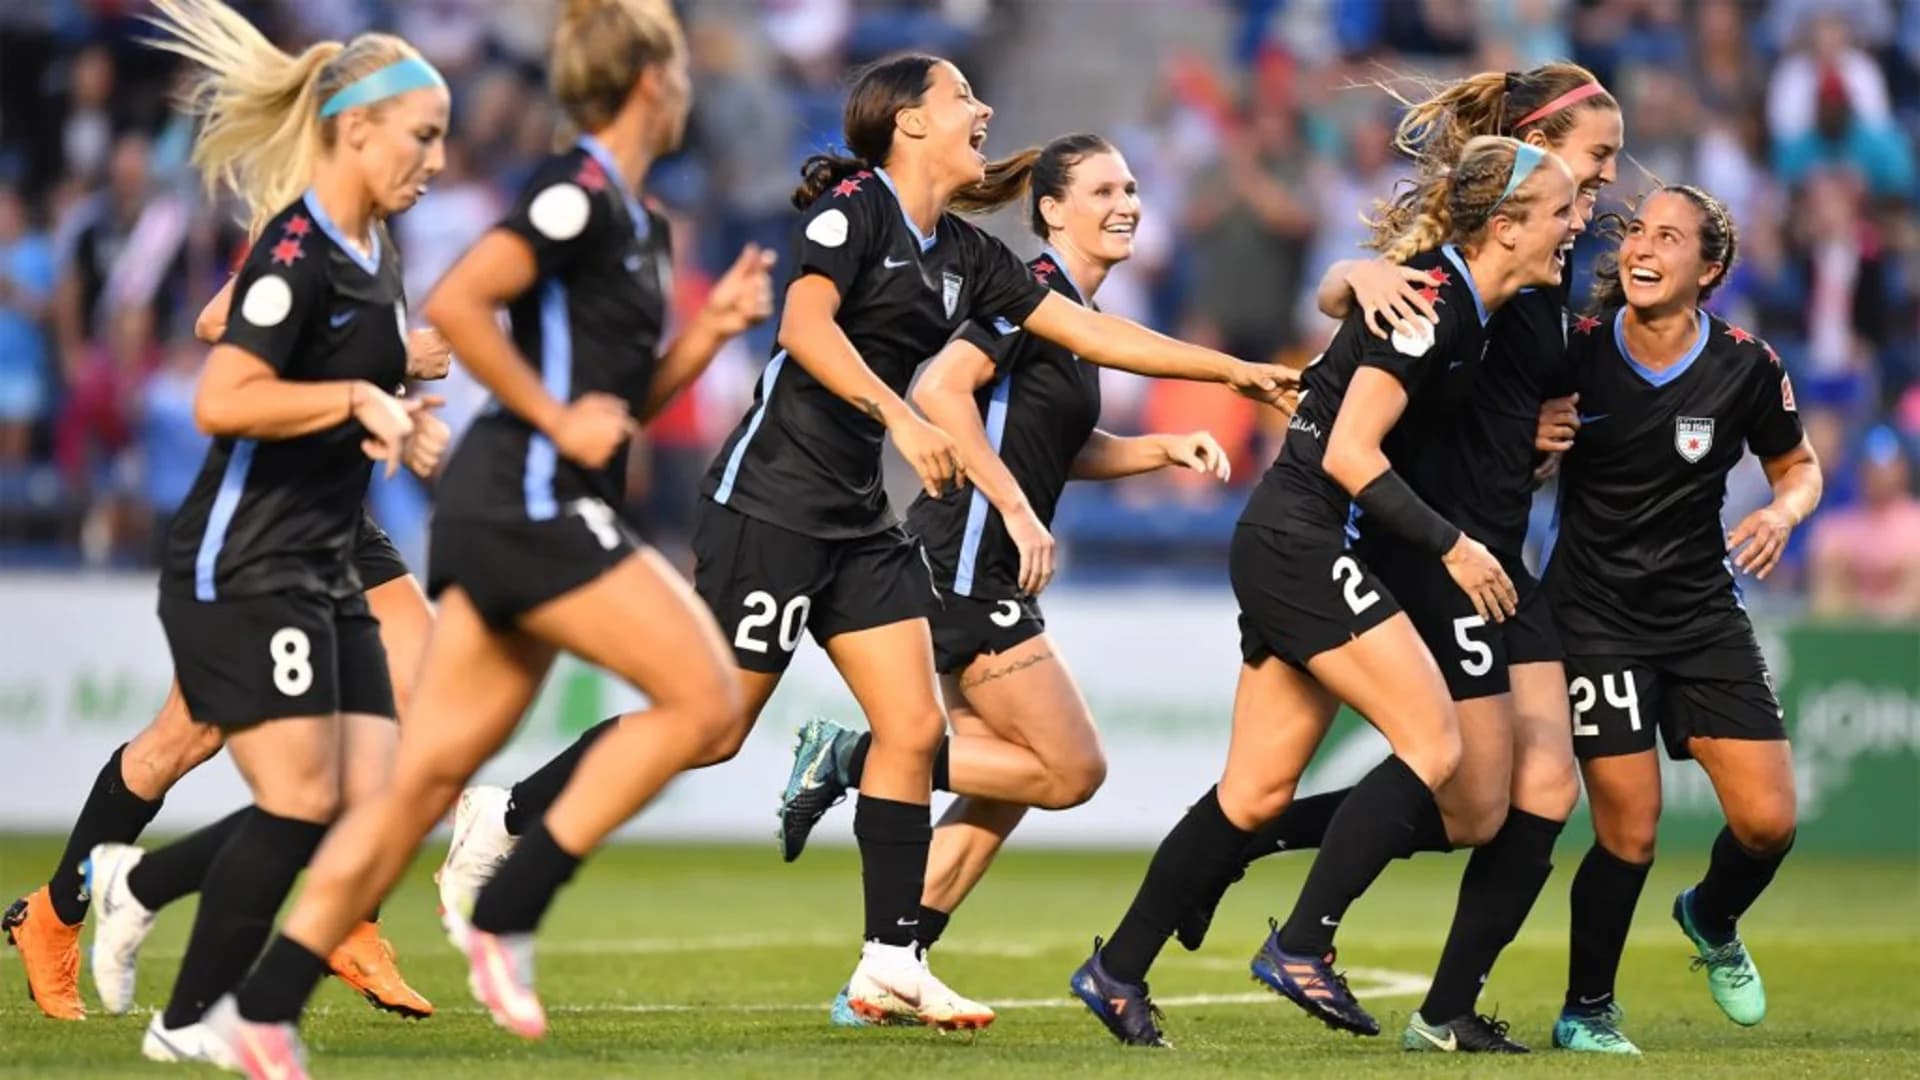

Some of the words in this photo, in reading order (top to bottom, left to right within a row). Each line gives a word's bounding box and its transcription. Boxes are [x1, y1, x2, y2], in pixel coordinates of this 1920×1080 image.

[1332, 556, 1381, 616] 2
[734, 590, 811, 654] 20
[1453, 614, 1494, 677] 5
[270, 627, 313, 696] 8
[1568, 669, 1642, 736] 24
